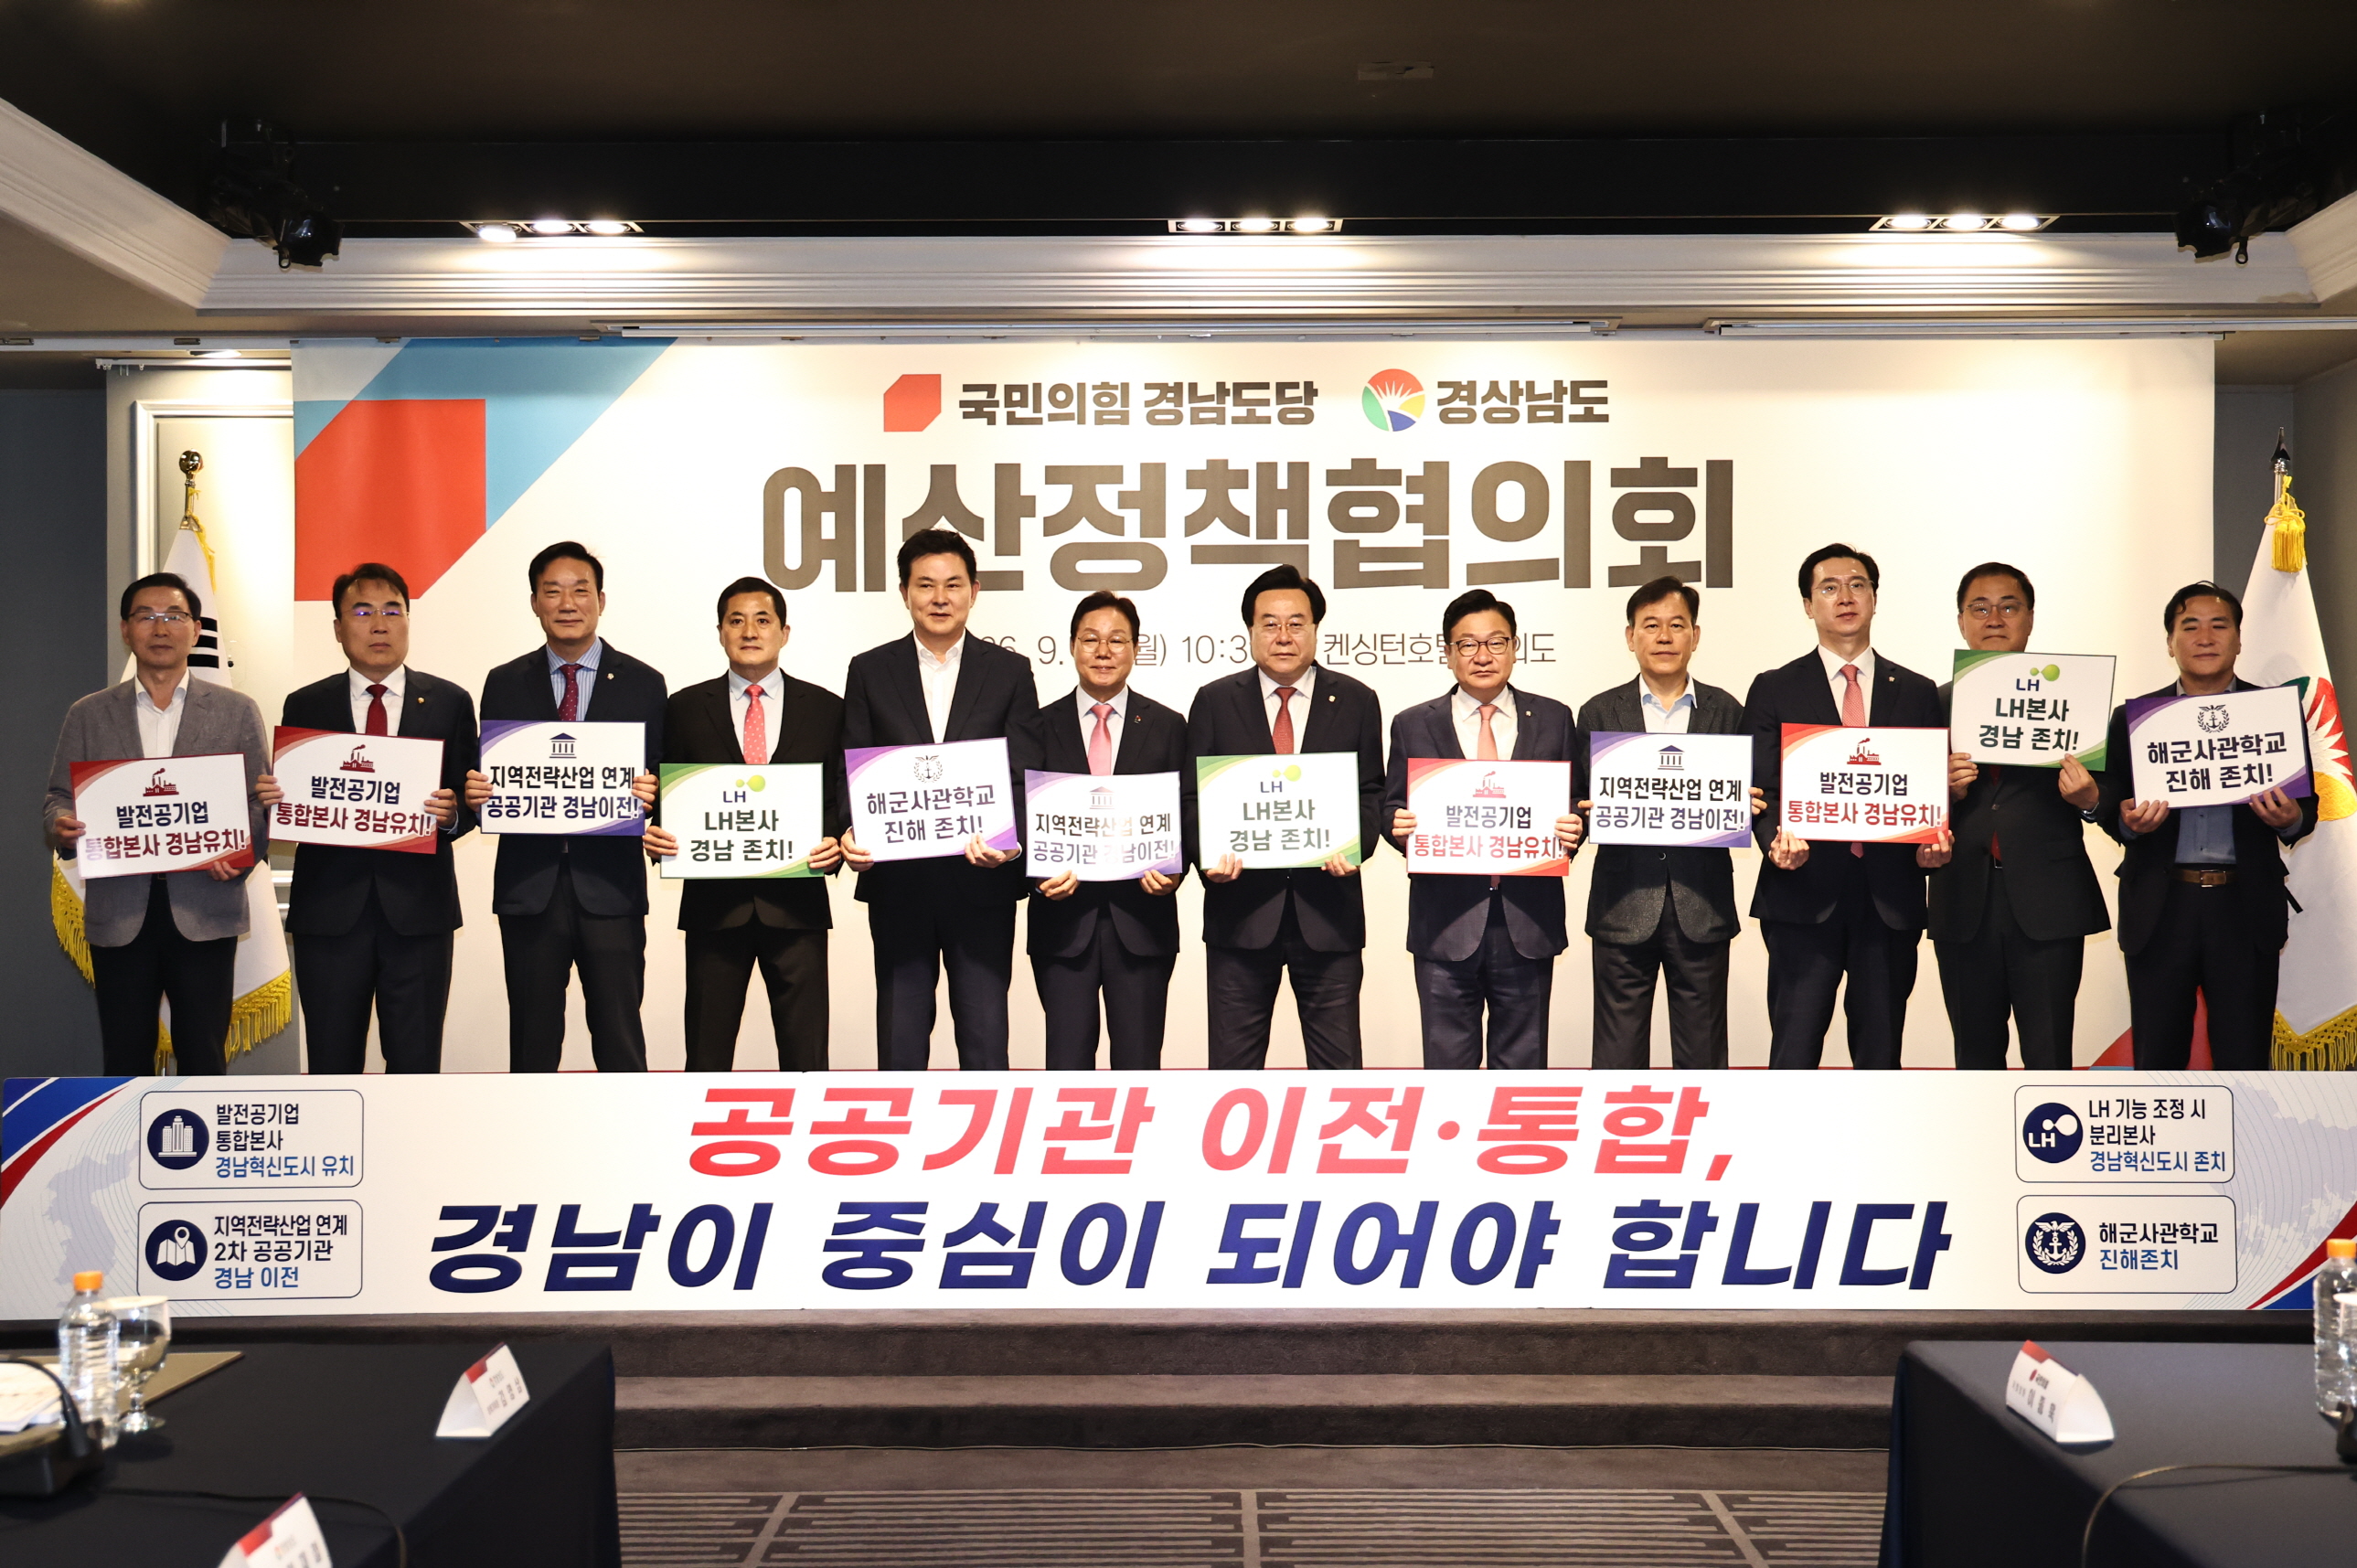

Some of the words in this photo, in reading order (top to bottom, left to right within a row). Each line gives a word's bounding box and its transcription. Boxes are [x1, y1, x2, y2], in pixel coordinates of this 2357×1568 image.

[959, 382, 1130, 425] 국민의힘
[1144, 380, 1319, 425] 경남도당
[1437, 380, 1610, 424] 경상남도
[763, 457, 1733, 592] 예산정책협의회
[1182, 635, 1249, 664] 10:3
[2016, 678, 2040, 691] LH
[1996, 698, 2069, 721] LH본사
[1979, 725, 2023, 749] 경남
[2032, 728, 2078, 752] 존치!
[2148, 731, 2287, 763] 해군사관학교
[490, 766, 593, 789] 지역전략산업
[602, 767, 635, 789] 연계
[1261, 782, 1282, 793] LH
[1600, 777, 1701, 801] 지역전략산업
[1709, 780, 1741, 801] 연계
[1820, 772, 1907, 795] 발전공기업
[2166, 768, 2211, 793] 진해
[2220, 763, 2273, 788] 존치!
[312, 776, 400, 805] 발전공기업
[723, 791, 746, 803] LH
[867, 784, 995, 814] 해군사관학교
[117, 802, 208, 828] 발전공기업
[487, 796, 557, 818] 공공기관
[563, 796, 638, 818] 경남이전!
[1243, 799, 1315, 821] LH본사
[1446, 805, 1531, 828] 발전공기업
[1596, 806, 1664, 828] 공공기관
[1670, 808, 1744, 830] 경남이전!
[1787, 801, 1858, 824] 통합본사
[1864, 803, 1941, 827] 경남유치!
[277, 803, 348, 829] 통합본사
[354, 809, 432, 836] 경남유치!
[705, 810, 779, 831] LH본사
[885, 819, 926, 843] 진해
[935, 816, 983, 839] 존치!
[1036, 814, 1132, 837] 지역전략산업
[1140, 813, 1170, 835] 연계
[85, 834, 160, 861] 통합본사
[166, 829, 246, 855] 경남유치!
[691, 840, 734, 861] 경남
[743, 839, 793, 860] 존치!
[1230, 829, 1272, 852] 경남
[1281, 828, 1329, 849] 존치!
[1414, 835, 1483, 857] 통합본사
[1489, 837, 1563, 859] 경남유치!
[1034, 840, 1097, 864] 공공기관
[217, 1103, 299, 1125] 발전공기업
[2089, 1100, 2109, 1119] LH
[2116, 1098, 2147, 1120] 기능
[2153, 1098, 2184, 1120] 조정
[2191, 1098, 2205, 1119] 시
[216, 1130, 283, 1152] 통합본사
[688, 1086, 1156, 1178] 공공기관
[2028, 1133, 2055, 1148] LH
[2090, 1125, 2156, 1146] 분리본사
[216, 1155, 315, 1178] 경남혁신도시
[322, 1155, 354, 1177] 유치
[2090, 1151, 2187, 1172] 경남혁신도시
[2194, 1151, 2225, 1172] 존치
[214, 1215, 311, 1237] 지역전략산업
[316, 1214, 347, 1236] 연계
[2099, 1222, 2218, 1244] 해군사관학교
[215, 1241, 248, 1263] 2차
[253, 1240, 333, 1262] 공공기관
[429, 1201, 774, 1294] 경남이
[821, 1200, 1166, 1291] 중심이
[1205, 1200, 1562, 1290] 되어야
[1603, 1199, 1953, 1290] 합니다
[2100, 1249, 2178, 1270] 진해존치
[215, 1267, 254, 1289] 경남
[261, 1267, 299, 1288] 이전
